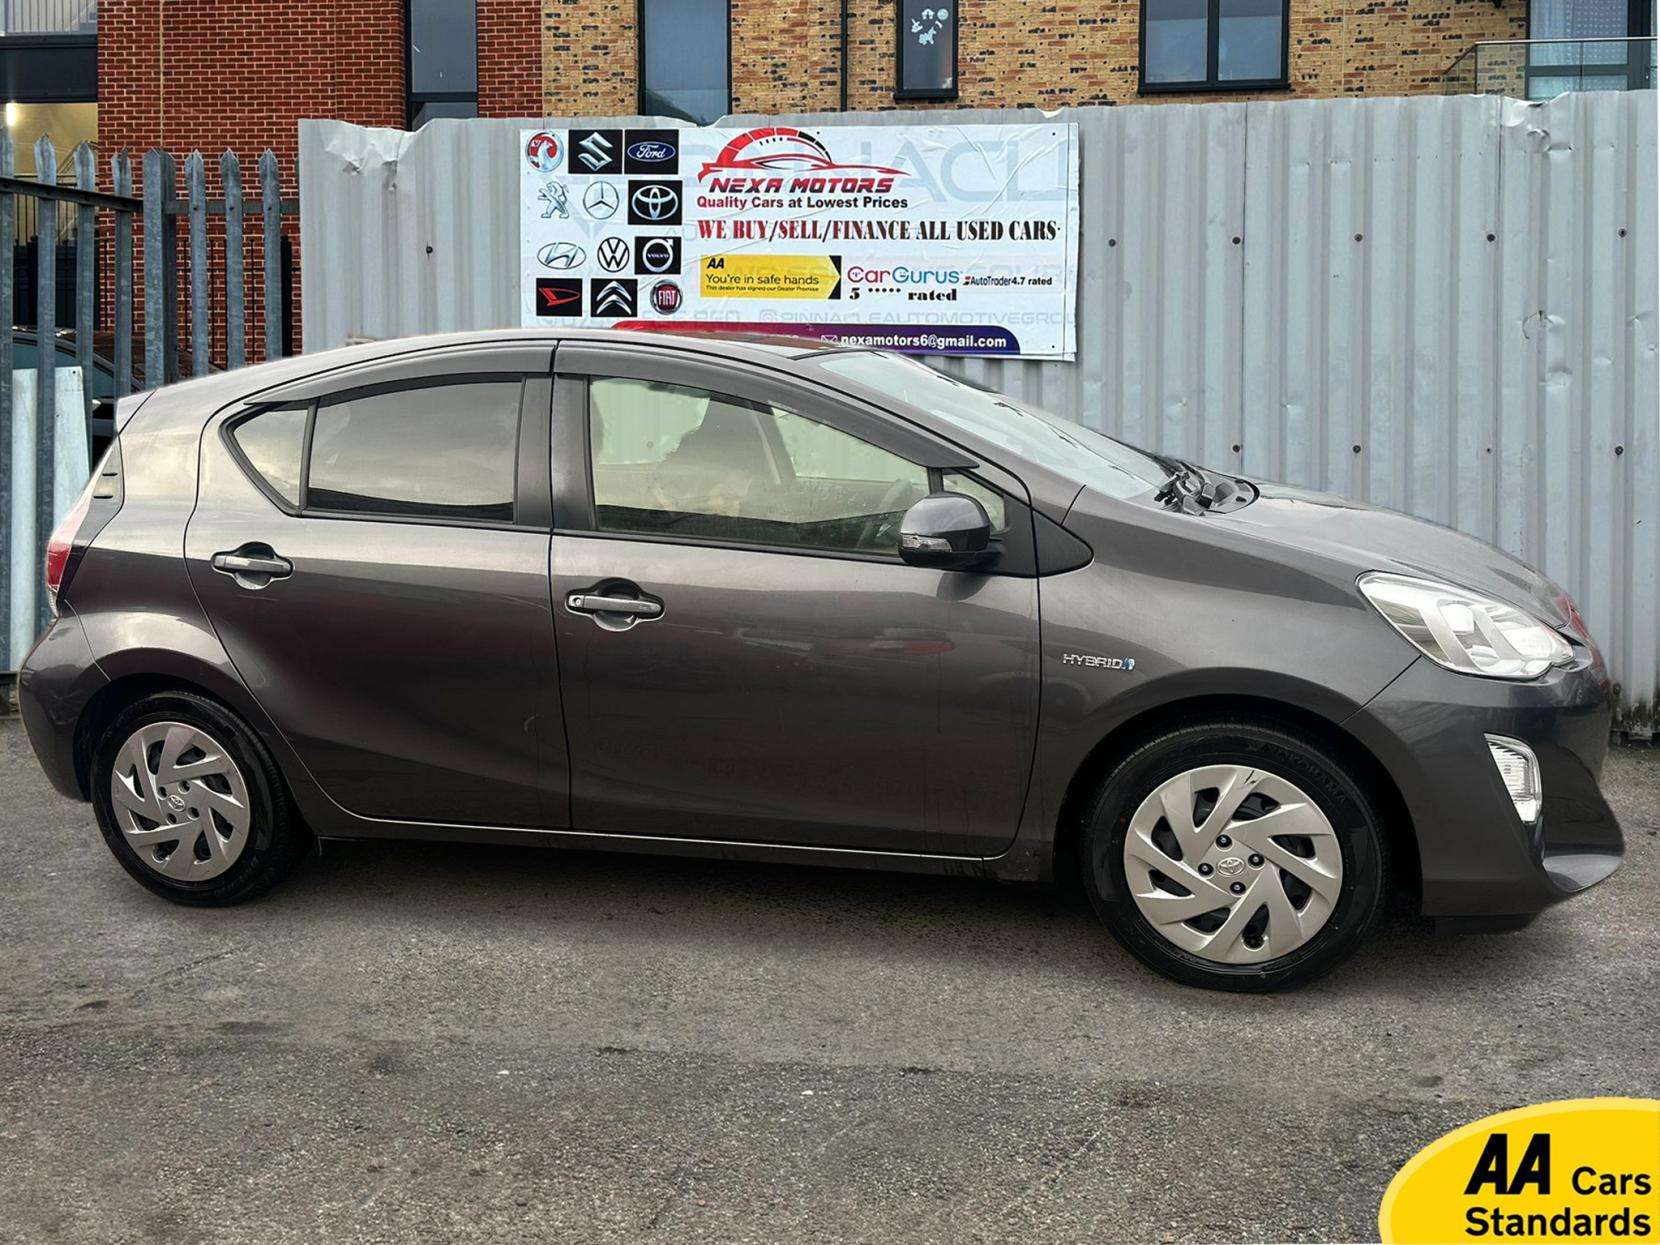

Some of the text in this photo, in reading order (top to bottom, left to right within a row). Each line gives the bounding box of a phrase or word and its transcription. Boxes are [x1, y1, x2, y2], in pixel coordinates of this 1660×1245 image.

[636, 144, 666, 159] Ford
[708, 177, 895, 193] NEXA MOTORS
[697, 196, 908, 210] Quality Cars at Lowest Prices
[697, 220, 726, 240] WE
[916, 220, 951, 240] ALL
[956, 220, 1004, 240] USED
[1009, 220, 1056, 240] CARS
[706, 257, 725, 269] AA
[706, 273, 819, 285] You're in safe hands
[847, 266, 960, 284] CarGurus
[1028, 276, 1053, 285] rated
[657, 290, 676, 306] FIAT
[849, 287, 958, 301] 5 rated
[841, 334, 1007, 349] nexamotors6@gmail.com
[1062, 653, 1123, 670] HYBRID
